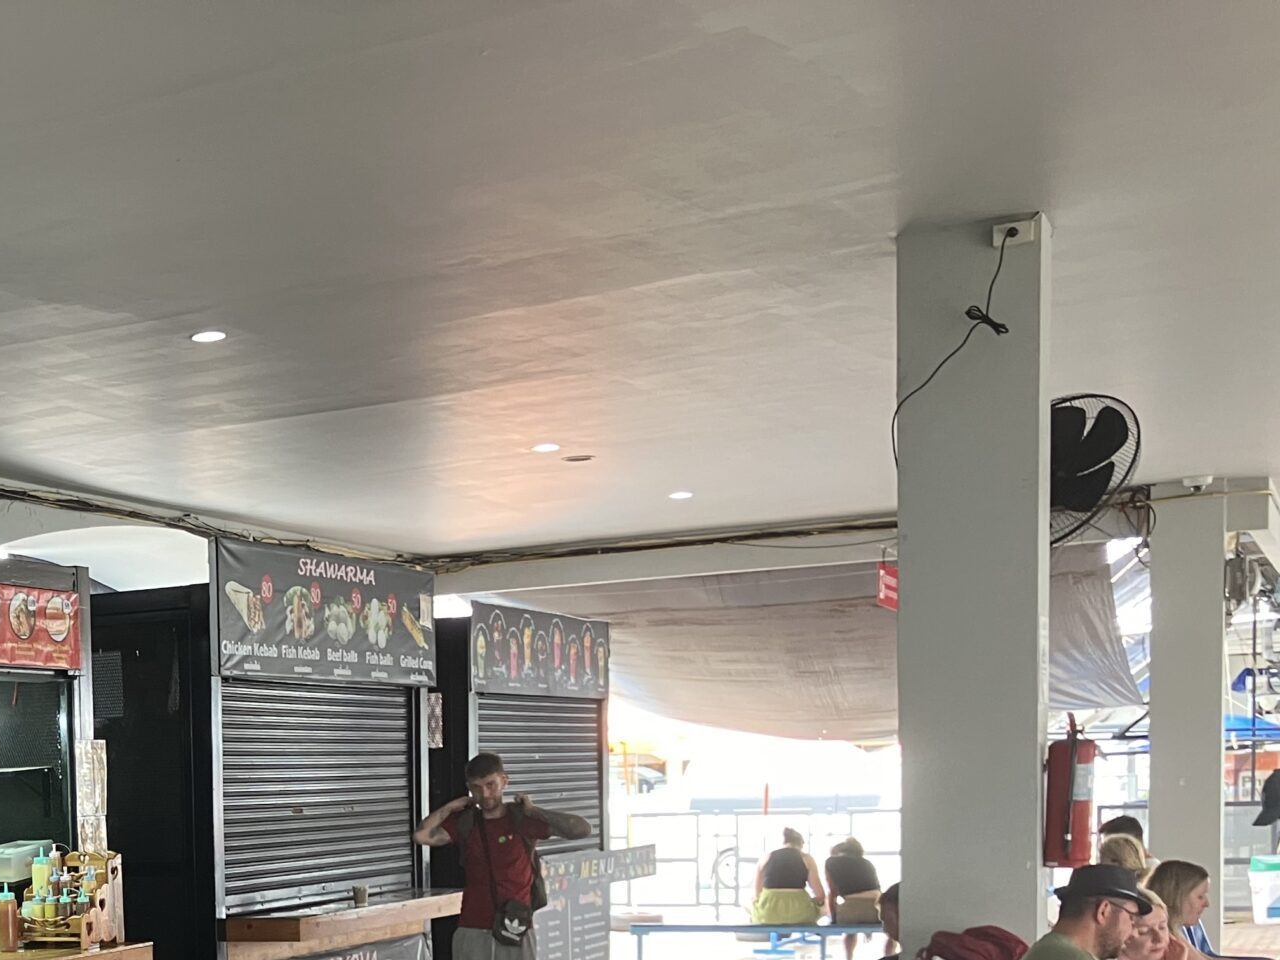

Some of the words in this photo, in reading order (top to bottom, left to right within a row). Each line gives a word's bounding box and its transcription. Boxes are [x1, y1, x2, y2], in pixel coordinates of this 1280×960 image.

[298, 558, 376, 586] SHAWARMA
[261, 581, 273, 598] 80
[310, 587, 321, 604] 80
[351, 593, 361, 609] 50
[387, 599, 397, 614] 50
[222, 640, 253, 656] Chicken
[253, 642, 278, 658] Kebab
[282, 644, 297, 659] Fish
[297, 645, 320, 660] Kebab
[327, 647, 342, 662] Beef
[365, 651, 379, 665] Fish
[580, 856, 615, 879] MENU
